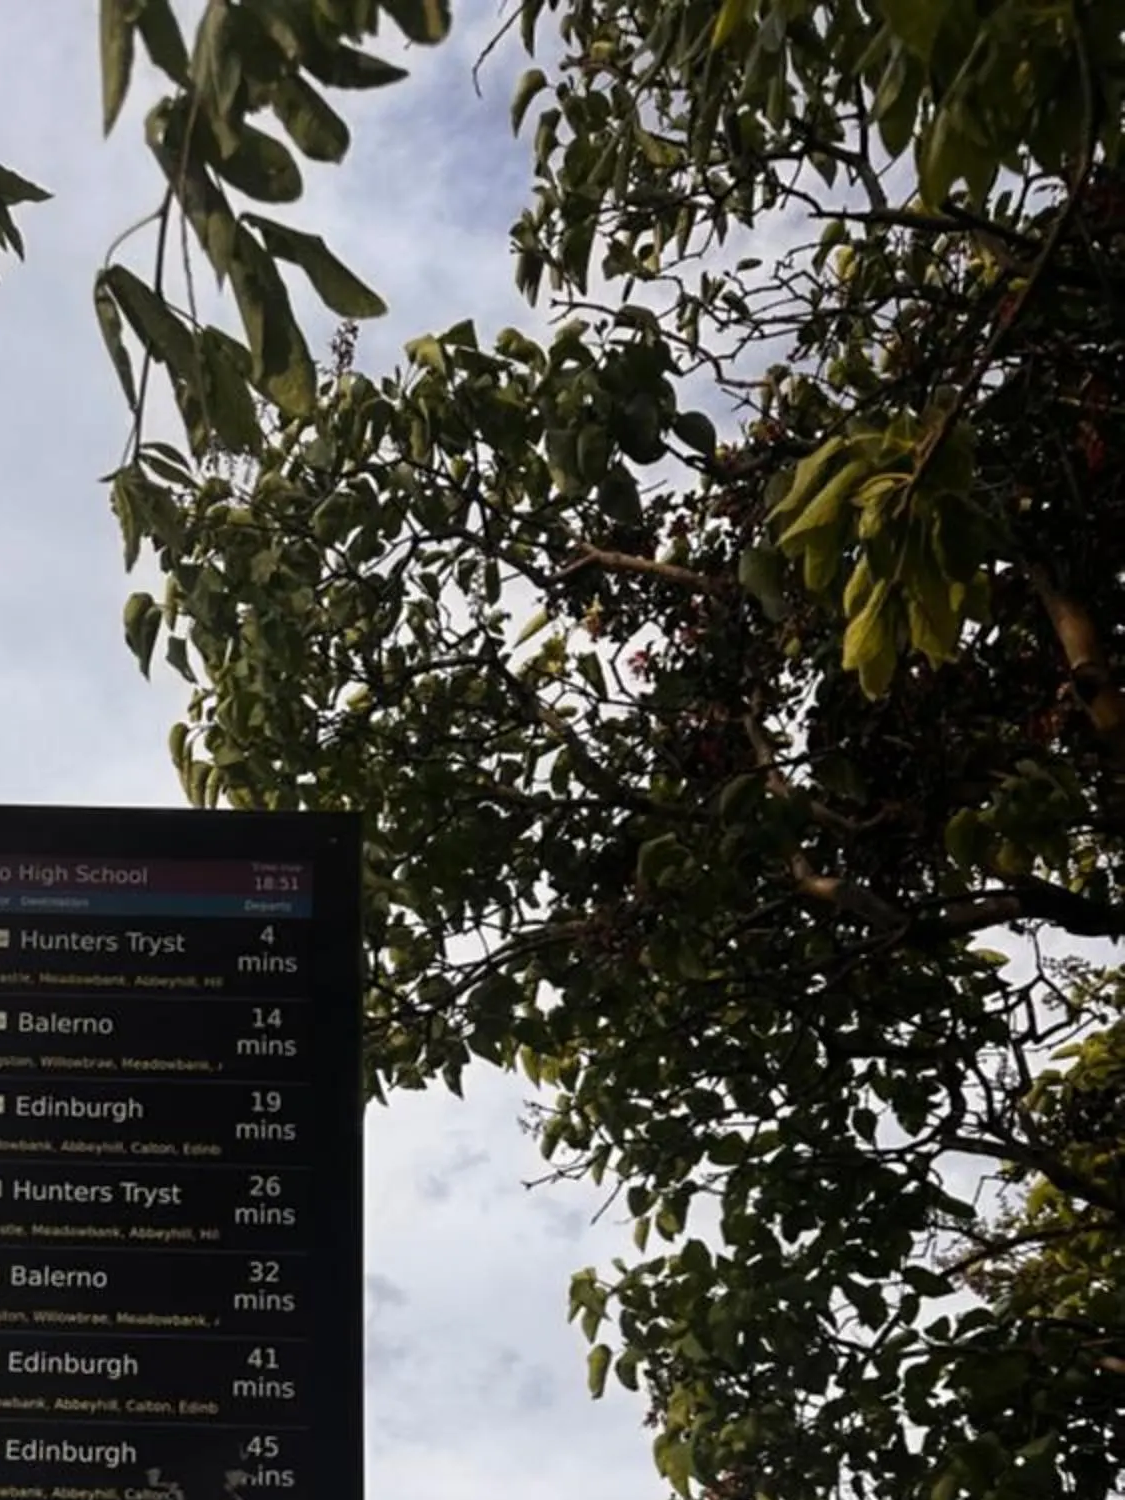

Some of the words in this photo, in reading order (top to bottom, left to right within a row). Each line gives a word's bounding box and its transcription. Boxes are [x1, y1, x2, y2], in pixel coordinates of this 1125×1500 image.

[19, 864, 68, 887] High
[75, 864, 149, 885] School
[20, 929, 118, 952] Hunters
[125, 931, 185, 957] Tryst
[260, 925, 275, 945] 4
[237, 951, 298, 973] mins
[18, 1011, 113, 1035] Balerno
[253, 1007, 282, 1028] 14
[236, 1039, 297, 1057] mins
[15, 1095, 143, 1123] Edinburgh
[252, 1091, 282, 1113] 19
[235, 1119, 296, 1141] mins
[13, 1179, 113, 1203] Hunters
[119, 1181, 181, 1208] Tryst
[250, 1175, 281, 1197] 26
[234, 1203, 296, 1225] mins
[10, 1265, 108, 1289] Balerno
[249, 1261, 280, 1283] 32
[233, 1289, 295, 1312] mins
[8, 1351, 138, 1380] Edinburgh
[247, 1347, 279, 1369] 41
[232, 1375, 295, 1399] mins
[5, 1439, 137, 1469] Edinburgh
[246, 1435, 279, 1458] 45
[238, 1465, 294, 1487] ins
